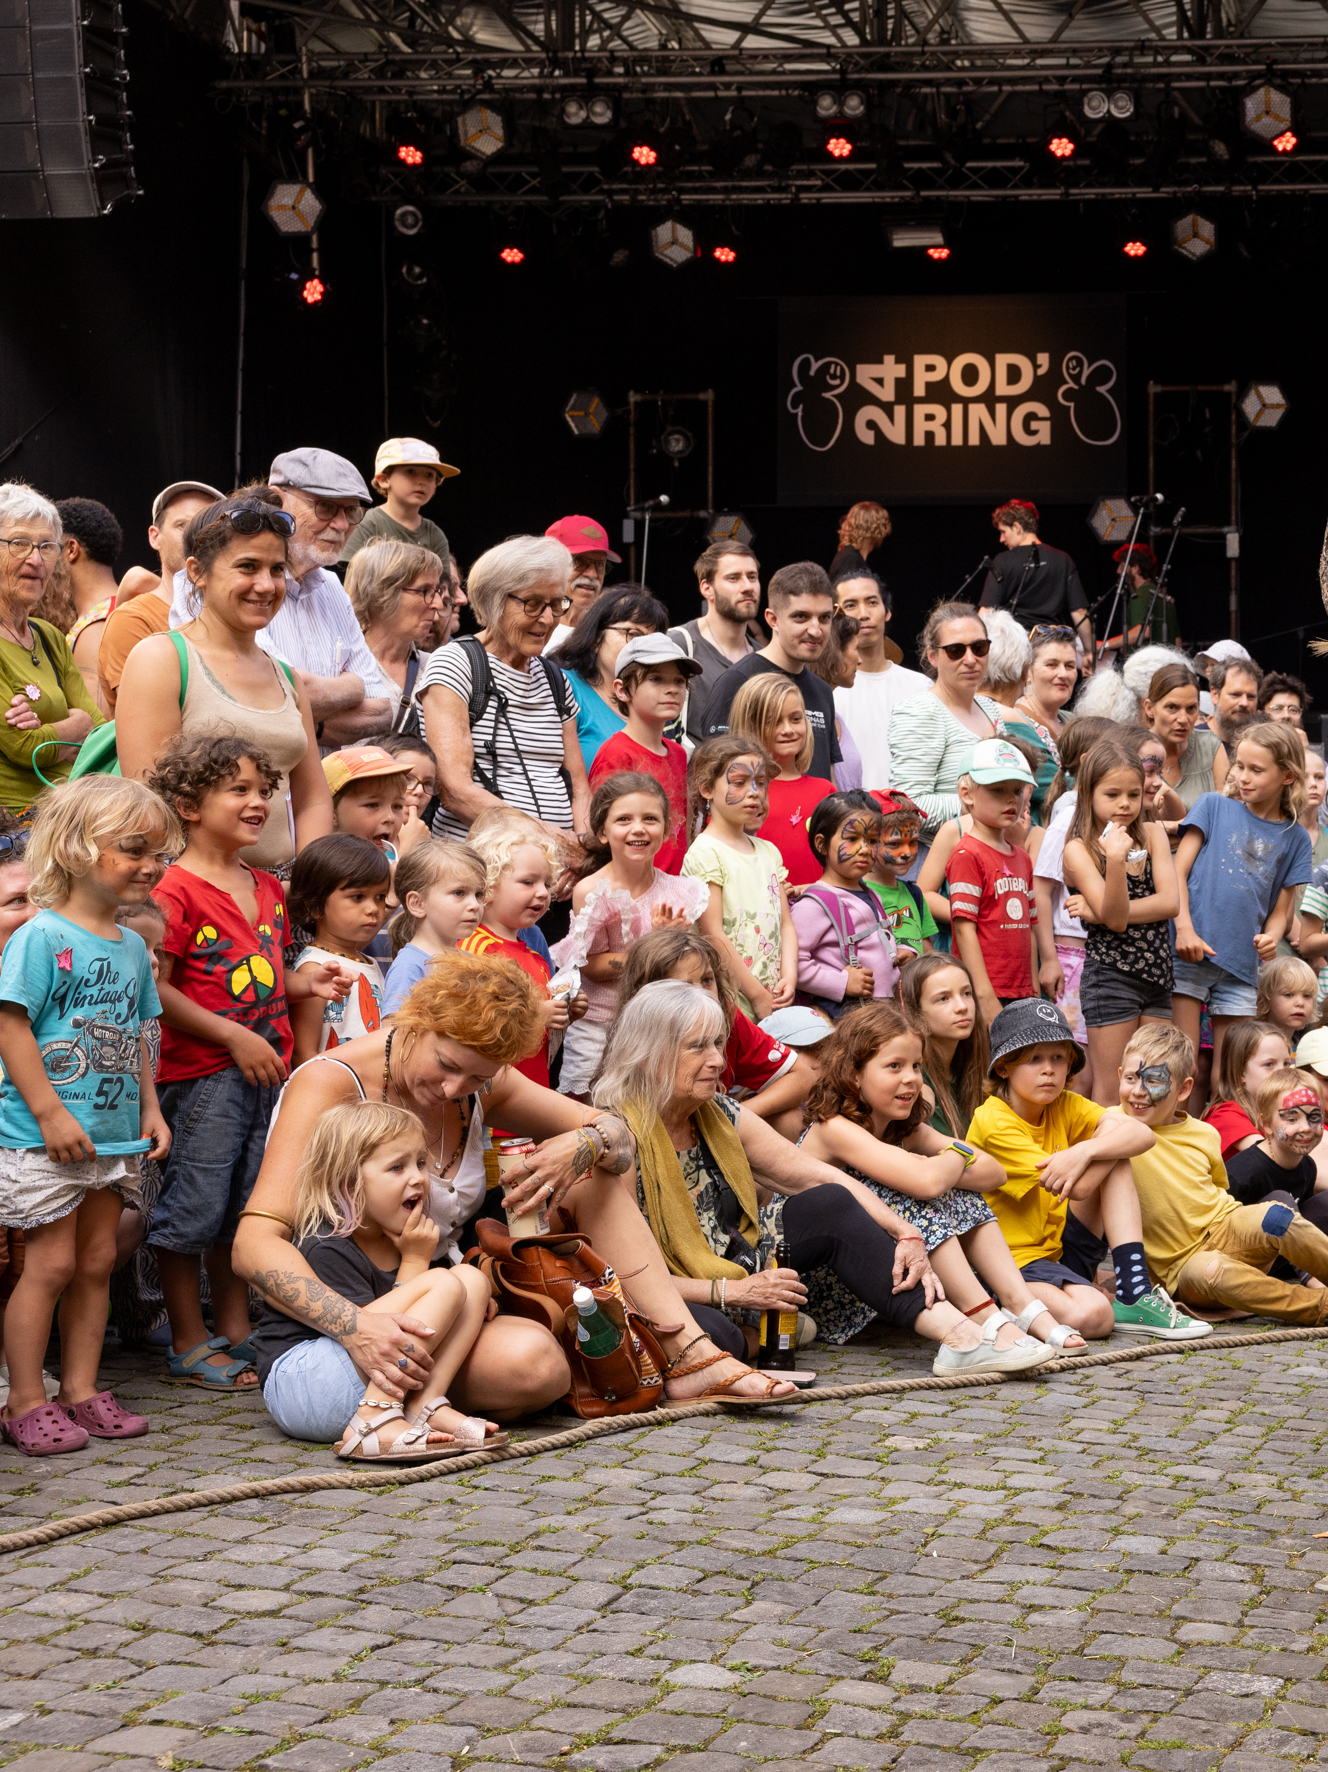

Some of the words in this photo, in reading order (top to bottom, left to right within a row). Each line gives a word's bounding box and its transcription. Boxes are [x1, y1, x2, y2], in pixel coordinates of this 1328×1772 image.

[854, 354, 906, 446] 24
[913, 401, 1052, 446] RING
[84, 956, 120, 988] The
[51, 975, 125, 1021] Vintage
[225, 1000, 286, 1022] OLODUM
[56, 1090, 94, 1101] IGINAL
[93, 1076, 124, 1111] 52
